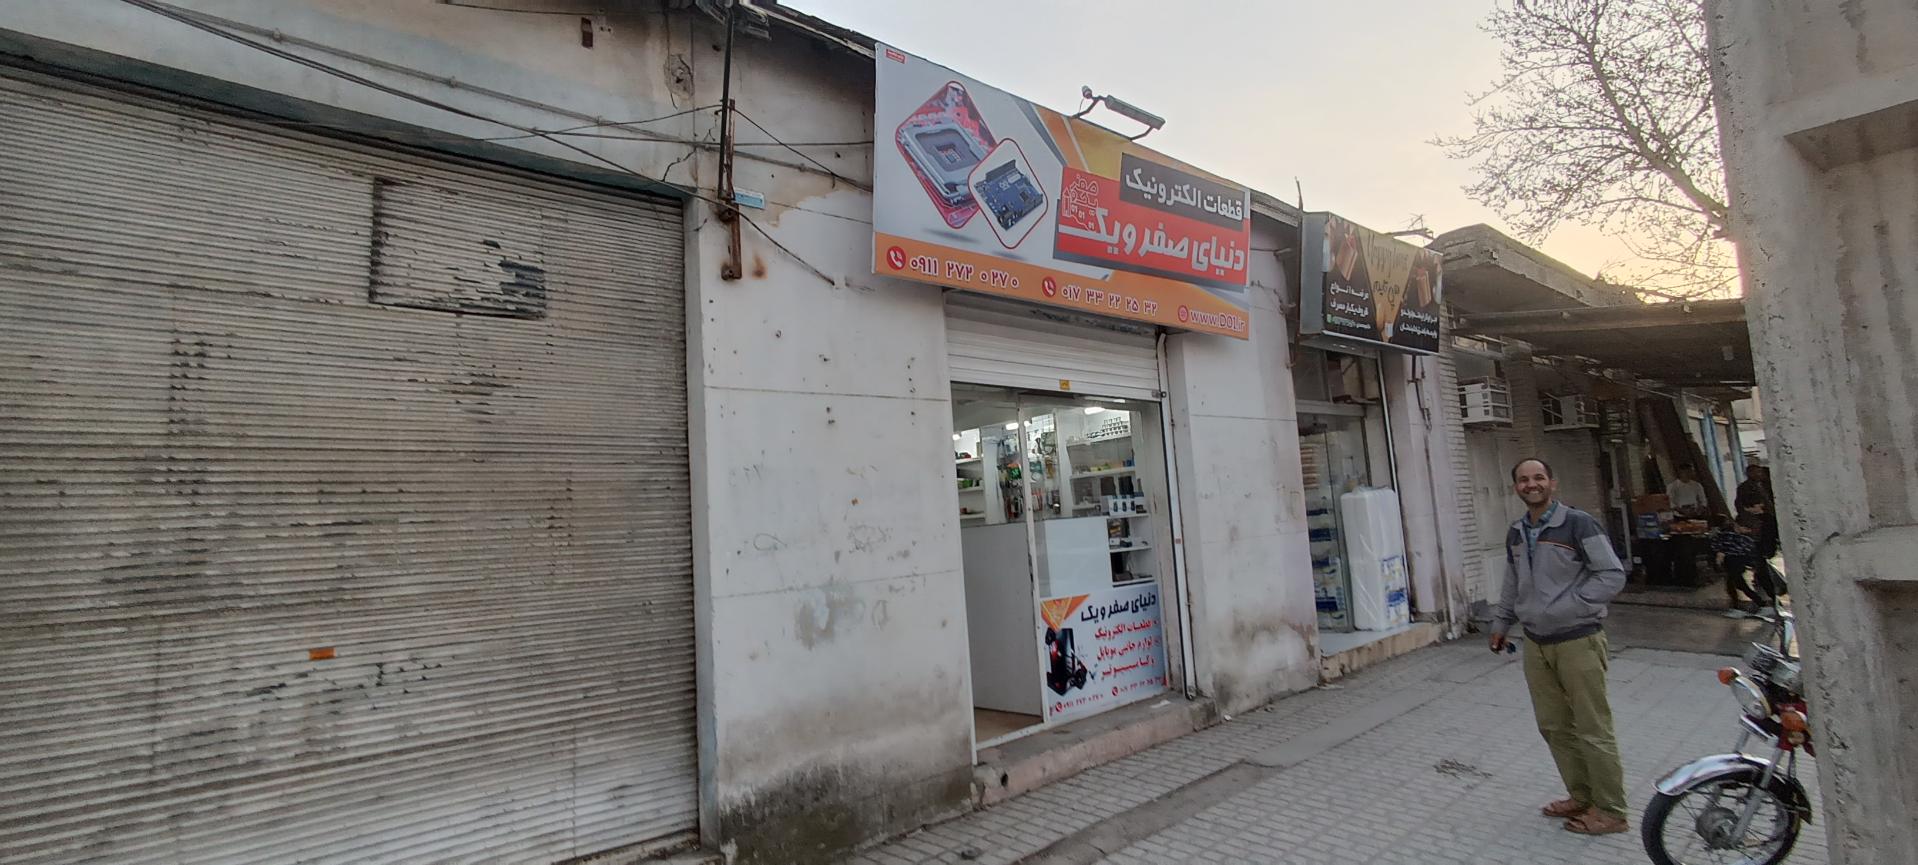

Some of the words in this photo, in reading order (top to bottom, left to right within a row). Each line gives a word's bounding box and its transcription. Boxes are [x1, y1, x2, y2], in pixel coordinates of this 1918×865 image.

[1125, 167, 1202, 209] الکترونیک
[1203, 195, 1243, 222] قطعات
[1138, 222, 1190, 258] صفر
[910, 255, 939, 276] ۰۹۱۱
[945, 260, 974, 281] ۲۷۲
[1191, 236, 1246, 276] دنیای
[1062, 284, 1081, 301] ۰۱۷
[1085, 288, 1104, 305] ۳۳
[1108, 293, 1121, 309] ۲۲
[1125, 297, 1139, 313] ۲۵
[1143, 301, 1157, 316] ۳۲
[1081, 605, 1099, 624] یک
[1107, 600, 1130, 619] صفر
[1131, 592, 1156, 614] دنیای
